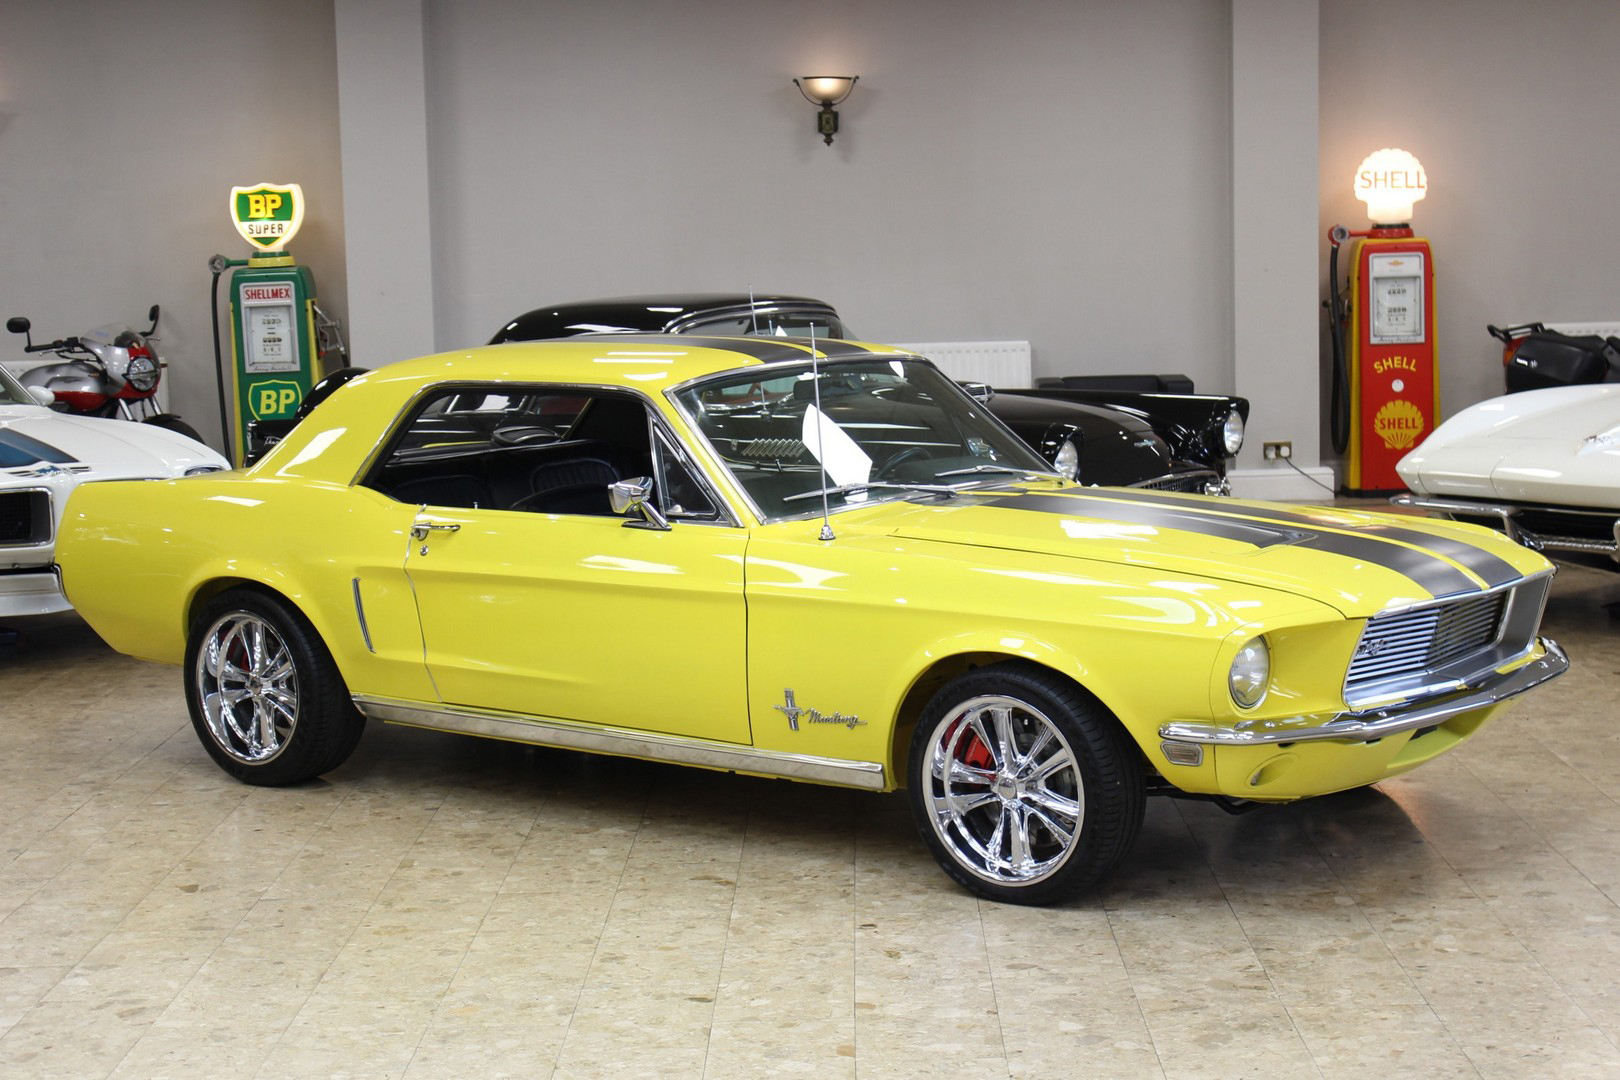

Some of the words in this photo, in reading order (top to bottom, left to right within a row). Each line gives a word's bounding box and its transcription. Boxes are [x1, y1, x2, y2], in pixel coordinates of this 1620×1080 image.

[1360, 170, 1425, 189] SHELL
[247, 193, 282, 219] BP
[248, 223, 284, 235] SUPER
[245, 287, 291, 300] SHELLMEX
[1373, 355, 1417, 374] SHELL
[259, 389, 296, 415] BP
[1379, 416, 1419, 430] SHELL
[808, 707, 867, 730] Mustang
